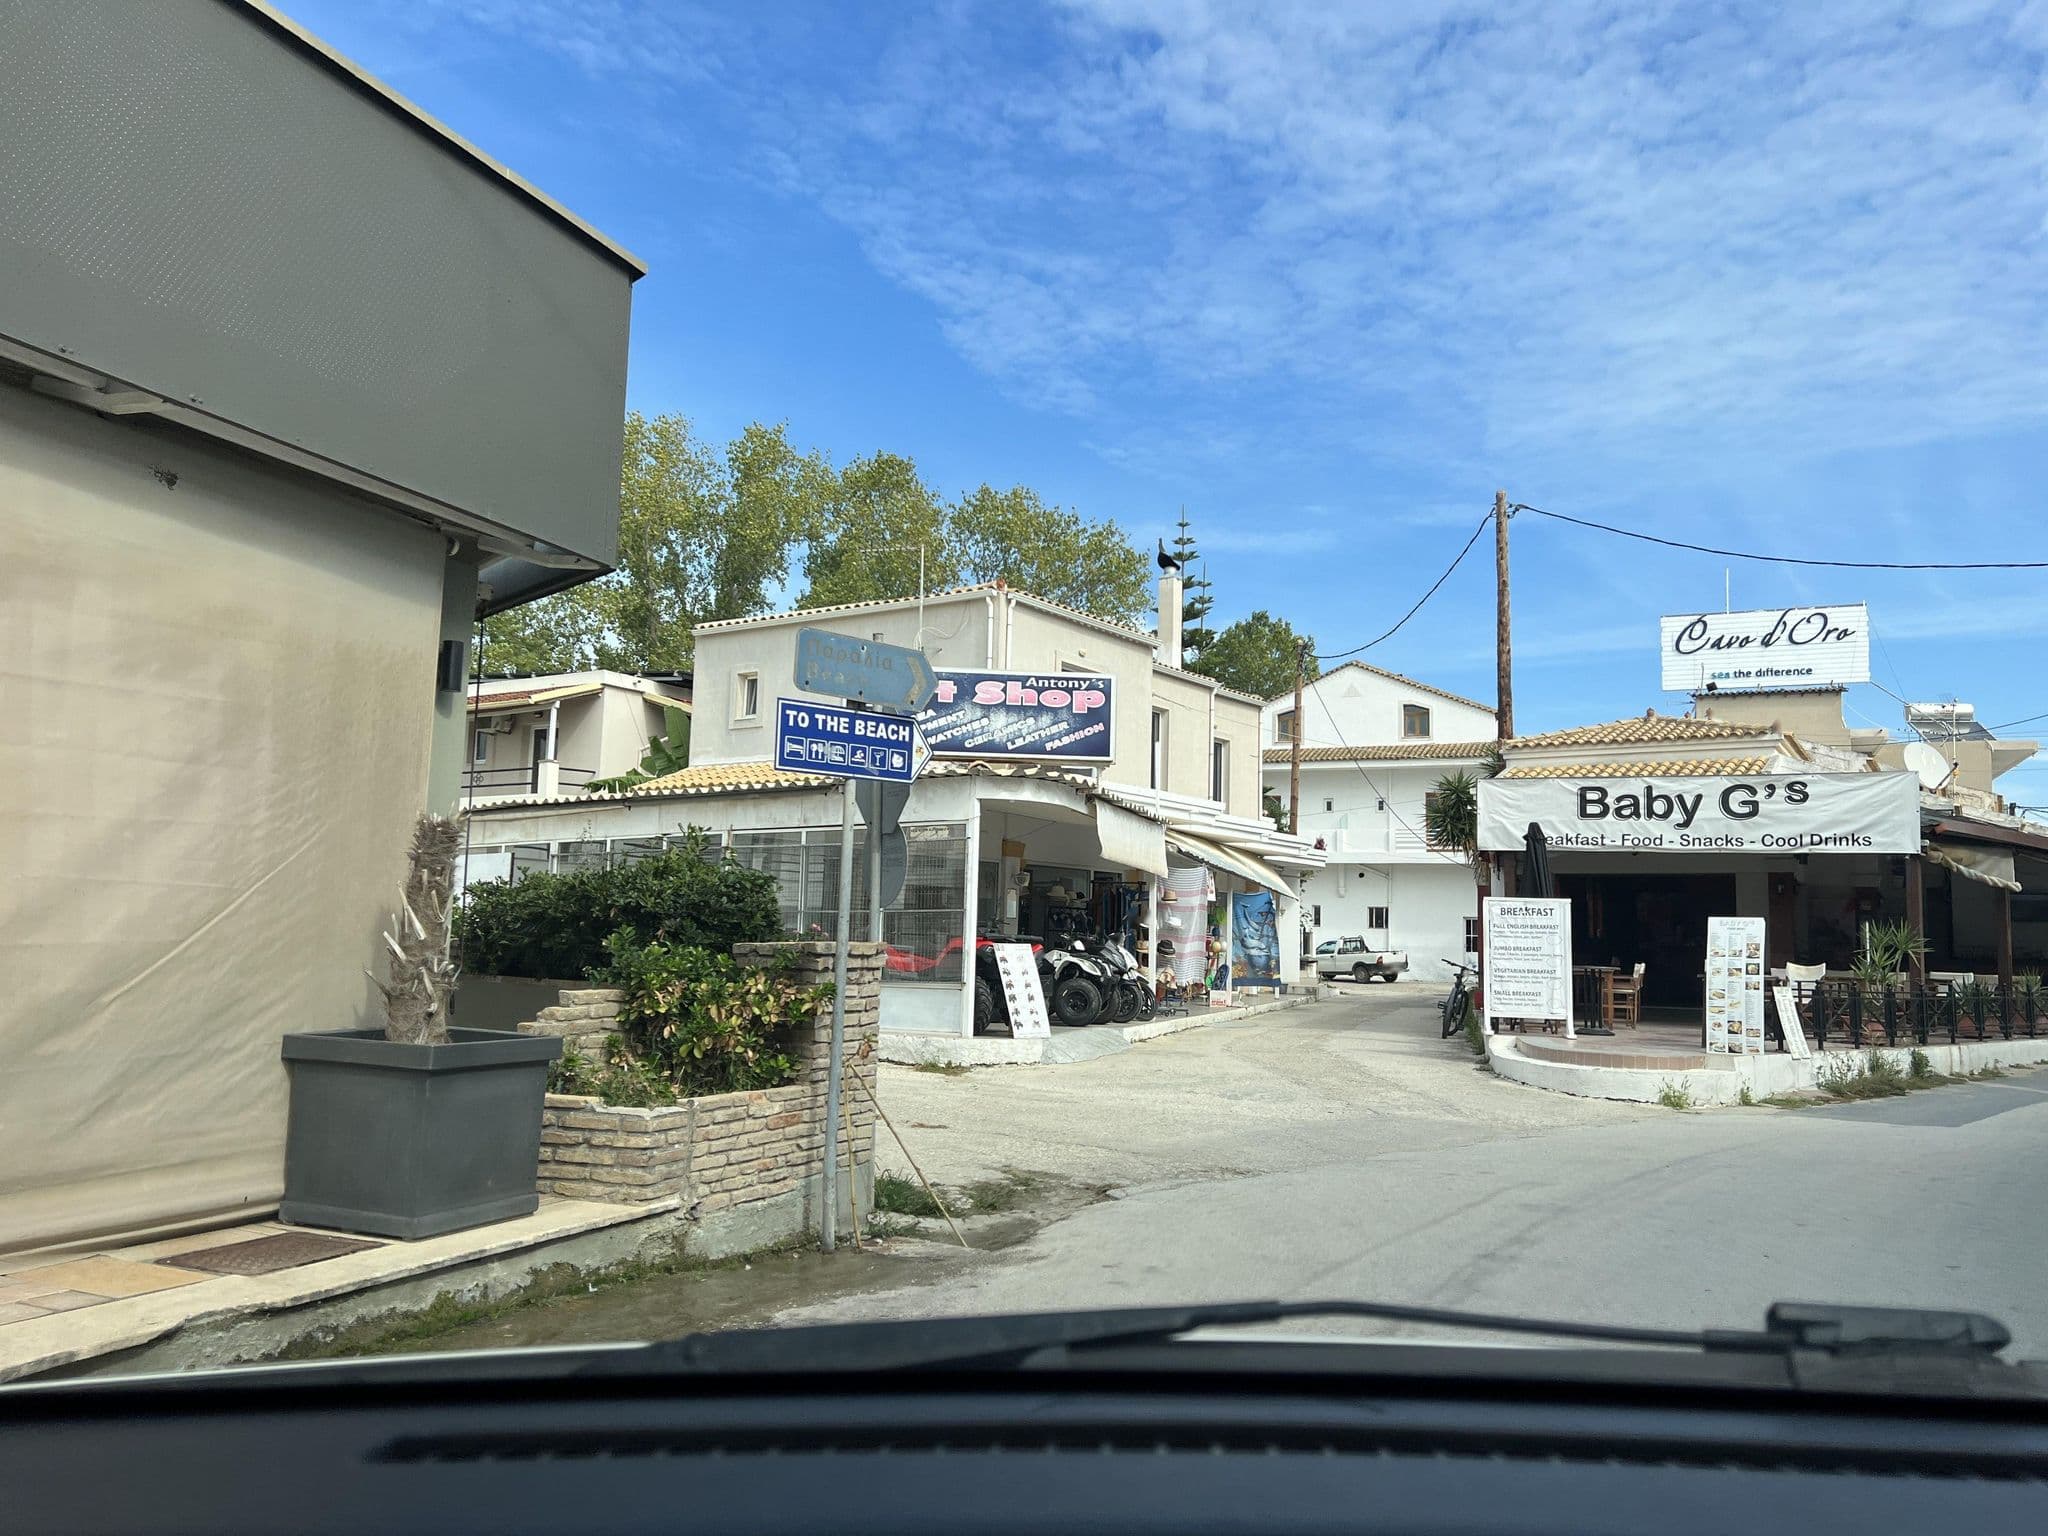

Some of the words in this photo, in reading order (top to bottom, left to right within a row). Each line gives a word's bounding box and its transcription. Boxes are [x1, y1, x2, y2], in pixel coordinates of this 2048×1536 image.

[1675, 614, 1757, 655] Cavo
[1733, 668, 1752, 679] the
[1755, 666, 1813, 678] difference
[974, 680, 1106, 714] Shop
[785, 710, 810, 728] TO
[815, 714, 849, 734] THE
[854, 719, 910, 742] BEACH
[964, 716, 1037, 749] CERAMICS
[1006, 720, 1070, 750] LEATHER
[1045, 722, 1105, 751] FASHION
[1577, 785, 1703, 831] Baby
[1545, 833, 1606, 847] eakfast
[1621, 833, 1663, 847] Food
[1679, 832, 1745, 848] Snacks
[1761, 832, 1803, 848] Cool
[1809, 832, 1873, 848] Drinks
[1500, 907, 1555, 917] BREAKFAST
